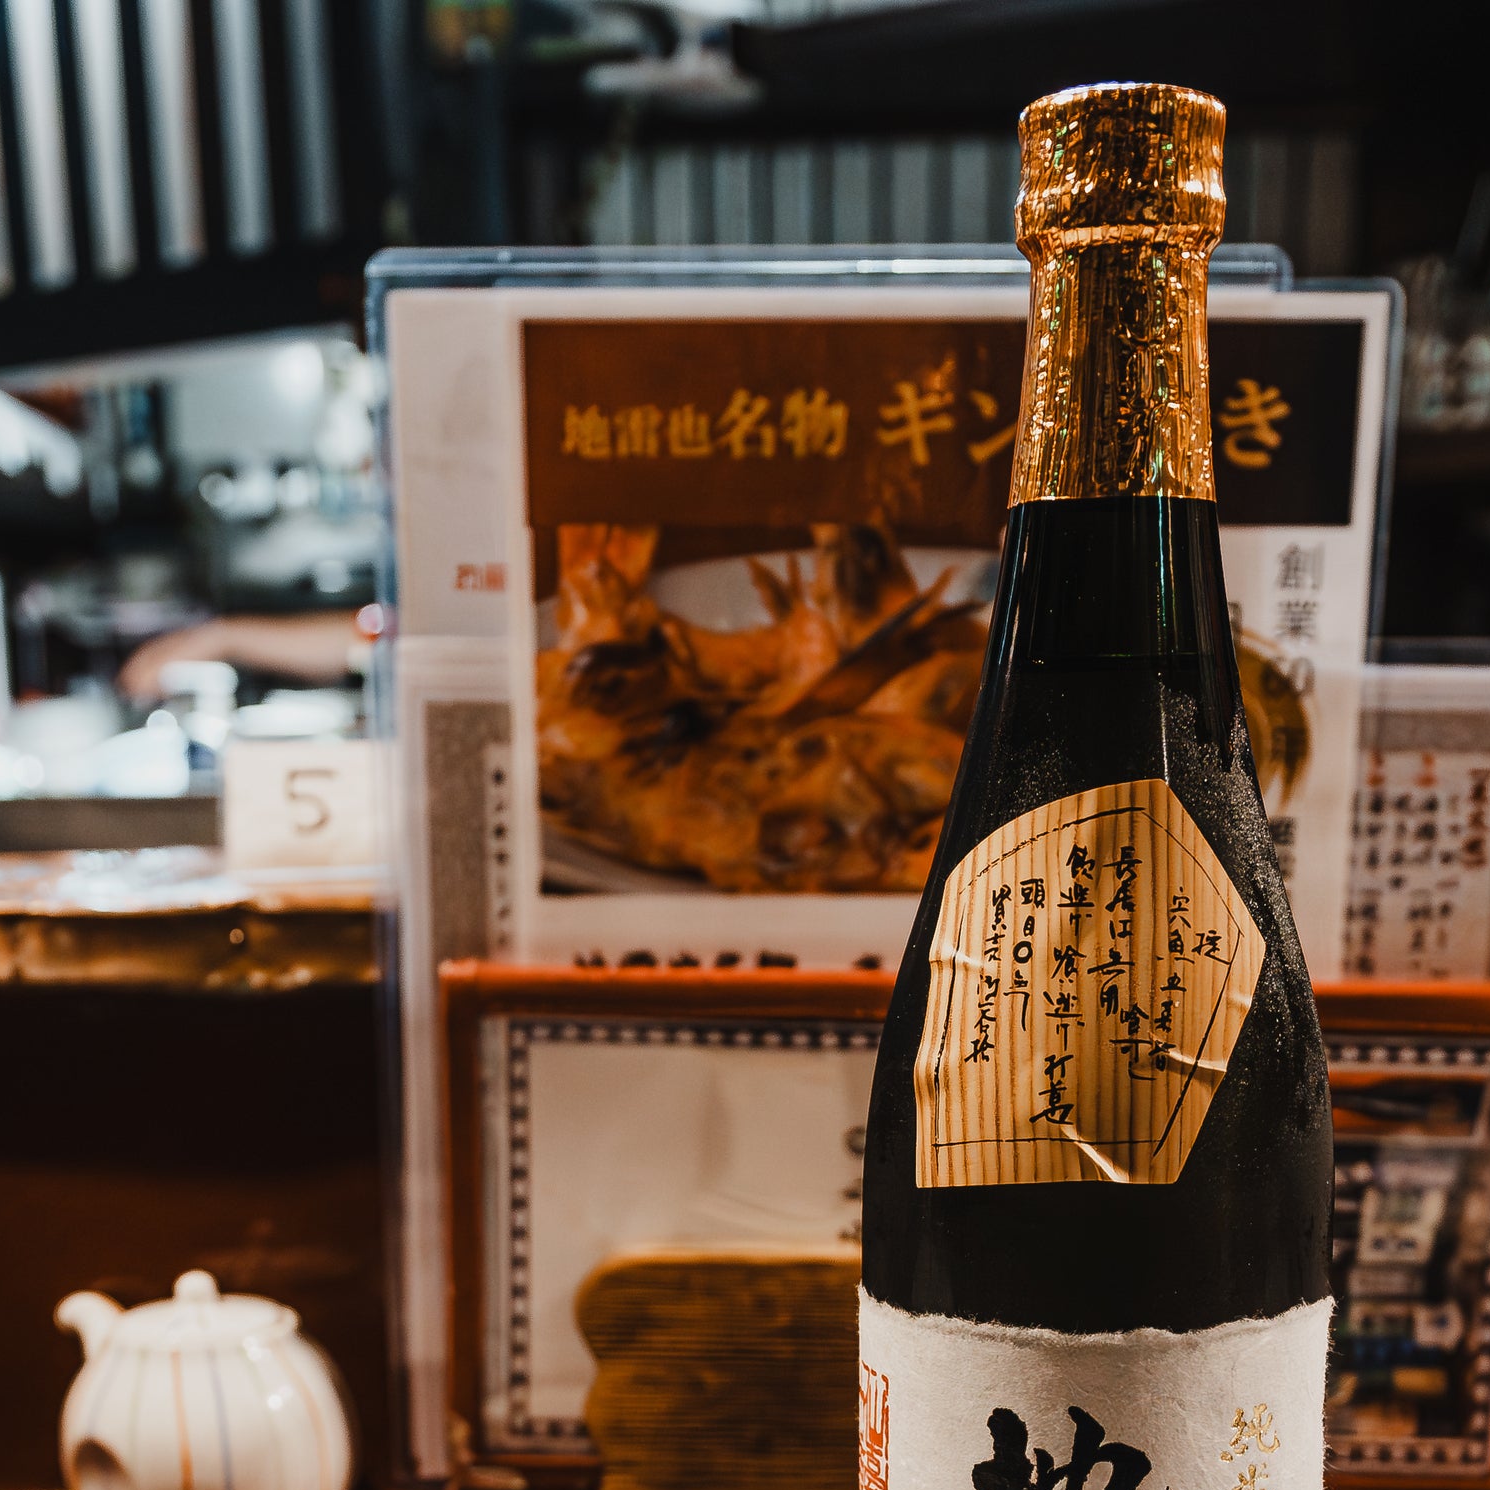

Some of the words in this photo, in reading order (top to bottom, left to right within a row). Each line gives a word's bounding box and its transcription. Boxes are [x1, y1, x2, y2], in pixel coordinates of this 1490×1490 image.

[561, 386, 851, 461] 地雷也名物
[285, 768, 338, 834] 5
